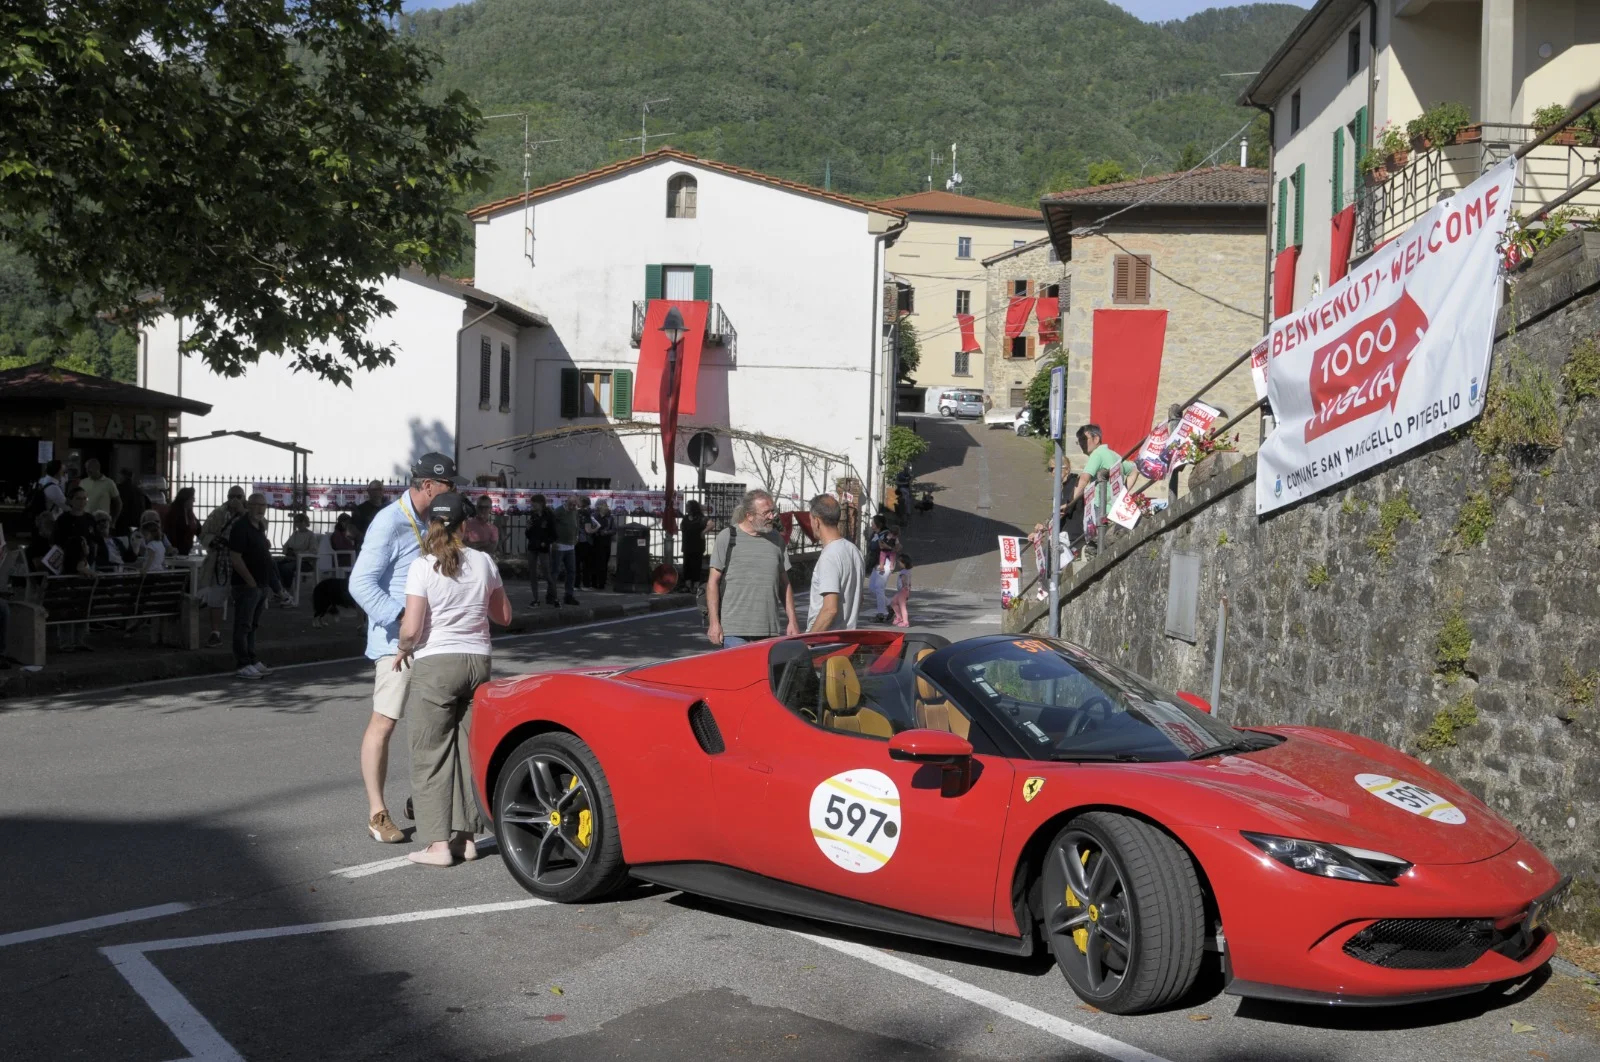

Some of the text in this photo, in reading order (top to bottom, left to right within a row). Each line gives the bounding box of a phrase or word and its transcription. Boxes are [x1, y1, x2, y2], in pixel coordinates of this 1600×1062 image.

[1320, 317, 1397, 384] 1000
[72, 411, 159, 441] BAR
[1286, 392, 1460, 490] COMUNE SAN MARCELLO PITEGLIO
[1012, 639, 1054, 653] 597
[1385, 786, 1436, 809] 597
[824, 793, 888, 844] 597
